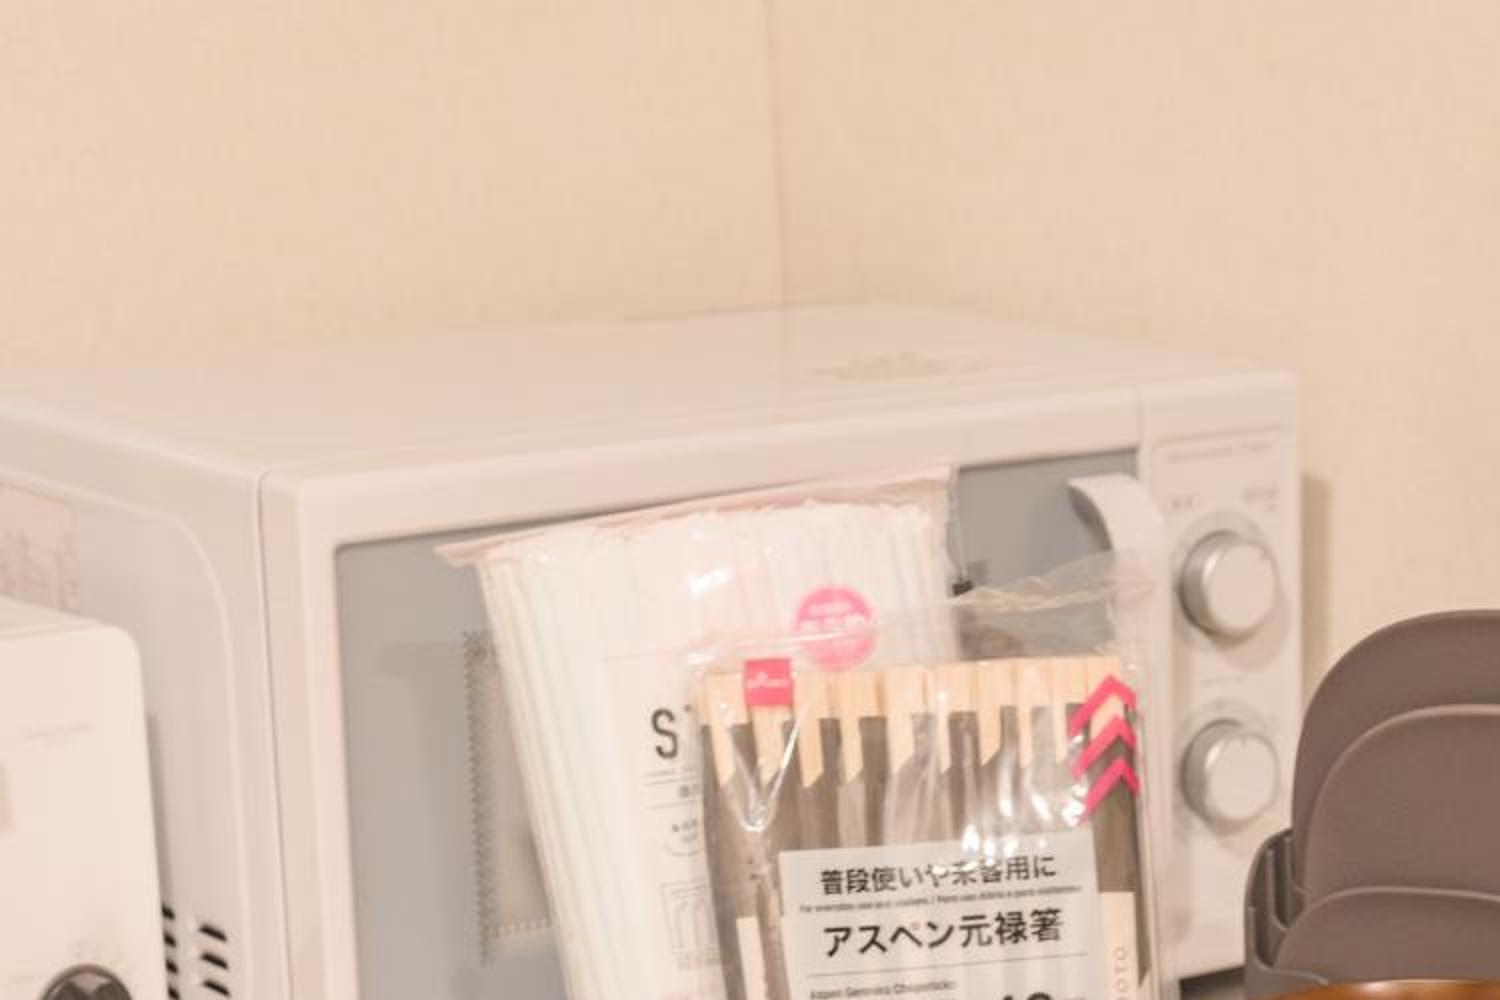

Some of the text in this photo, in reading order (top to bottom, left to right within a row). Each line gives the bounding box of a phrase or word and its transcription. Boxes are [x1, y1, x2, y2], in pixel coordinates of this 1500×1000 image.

[823, 908, 1065, 957] アスペン元禄箸
